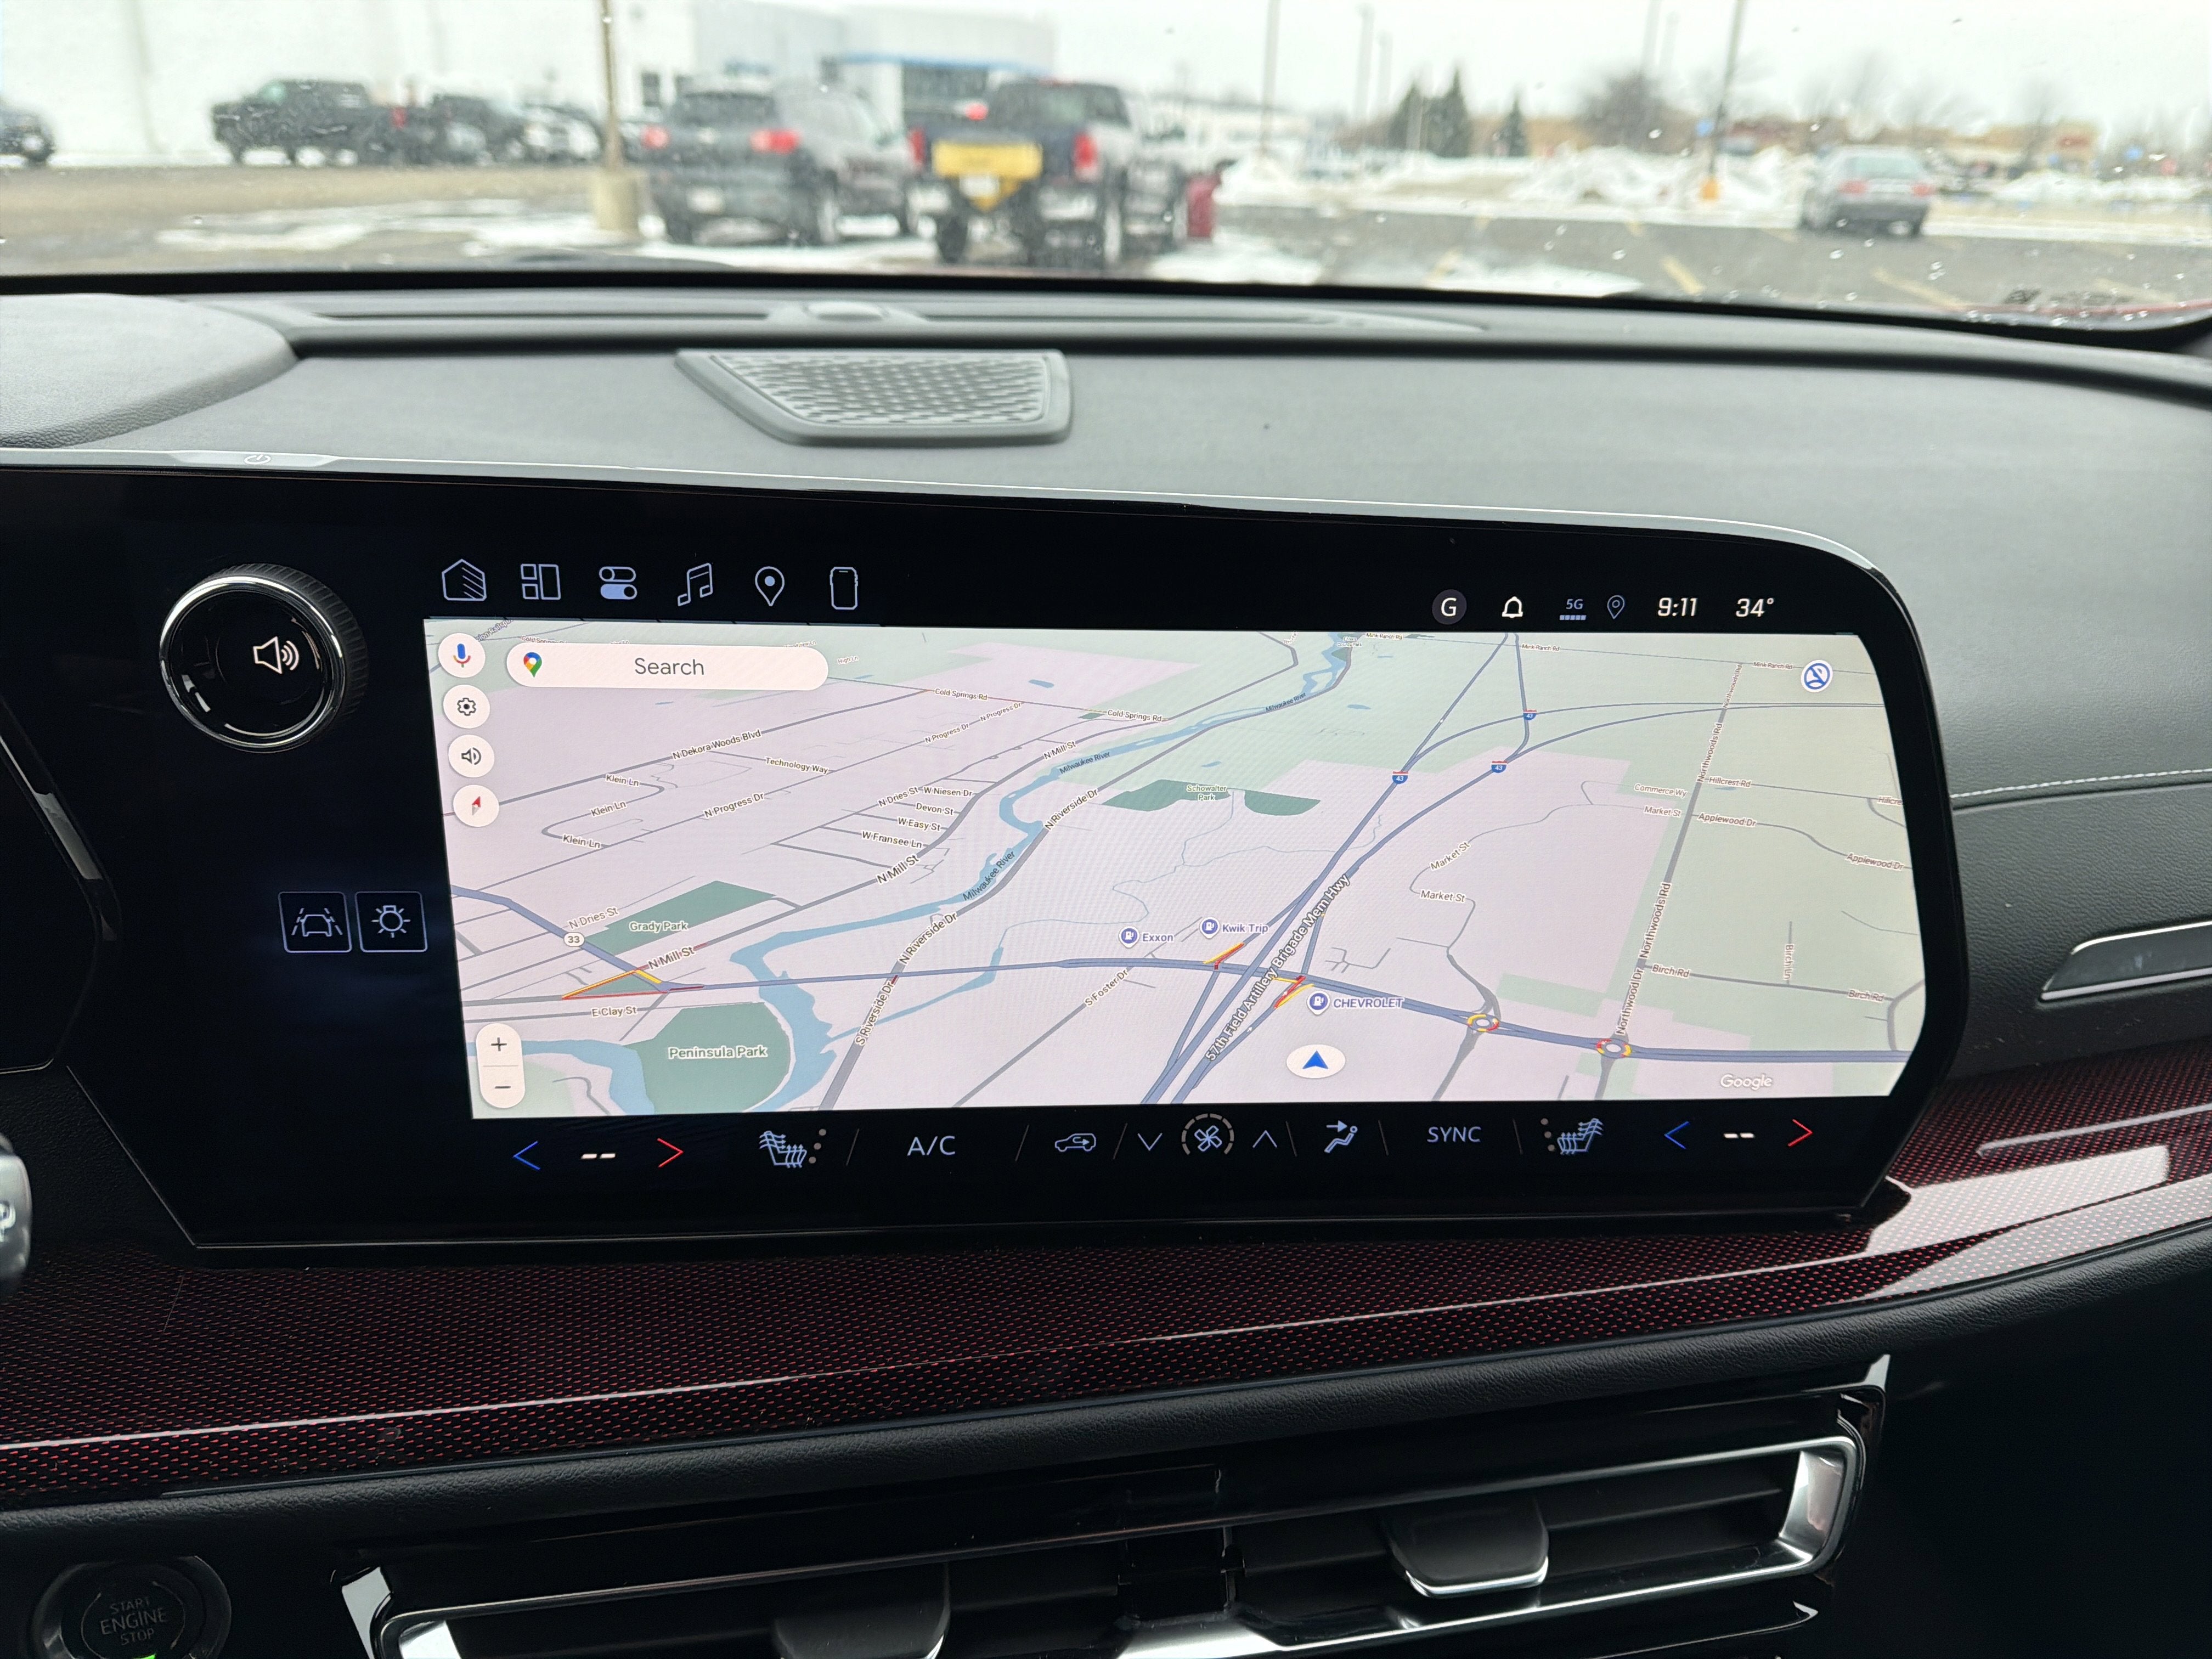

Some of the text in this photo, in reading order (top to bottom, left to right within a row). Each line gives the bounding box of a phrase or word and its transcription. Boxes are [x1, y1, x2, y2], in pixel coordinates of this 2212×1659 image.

[1441, 597, 1457, 616] G
[1566, 599, 1583, 610] 5G
[1658, 598, 1697, 617] 9:11
[1736, 598, 1774, 617] 34°
[635, 658, 704, 675] Search
[935, 689, 950, 697] Cold
[952, 690, 977, 700] Springs
[1723, 664, 1742, 708] Northwoods Rd
[1266, 692, 1306, 712] Milwaukee River
[987, 706, 1013, 720] Progress
[1125, 711, 1151, 720] Springs
[932, 726, 961, 742] Progress
[682, 743, 711, 757] Dekora
[712, 736, 741, 748] Woods
[742, 730, 761, 741] Blvd
[1051, 744, 1066, 758] Mill
[1067, 741, 1076, 749] St
[1697, 724, 1722, 782] Northwoods Rd
[766, 757, 828, 775] Technology Way
[1059, 752, 1110, 774] Milwaukee River
[606, 775, 639, 786] Klein Ln
[1709, 777, 1740, 786] Hillcrest
[888, 792, 908, 803] Dries
[1635, 784, 1686, 797] Commerce Wy
[591, 801, 626, 817] Klein Ln
[704, 793, 764, 817] N Progress Dr
[916, 803, 941, 813] Devon
[1045, 788, 1098, 830] N Riverside Dr
[1878, 797, 1903, 805] Hillcre
[1645, 806, 1671, 816] Market
[1699, 813, 1744, 826] Applewood
[909, 820, 929, 831] Easy
[563, 834, 601, 849] Klein Ln
[873, 833, 909, 845] Fransee
[911, 839, 922, 848] Ln
[1431, 842, 1470, 870] Market St
[1847, 853, 1892, 868] Applewood
[878, 855, 919, 884] N Mill St
[963, 851, 1015, 901] Milwaukee River
[1421, 890, 1465, 902] Market St
[569, 907, 618, 929] N Dries St
[1640, 883, 1671, 958] Northwoods Rd
[630, 922, 687, 932] Grady Park
[1249, 924, 1269, 934] Trip
[567, 935, 580, 944] 33
[899, 912, 957, 964] N Riverside Dr
[648, 946, 694, 969] N Mill St
[1784, 945, 1793, 979] Birch Ln
[1206, 874, 1351, 1060] 57th Field Artillery Brigade Mem Hwy
[1652, 964, 1690, 977] Birch Rd
[1085, 969, 1128, 1006] S Foster Dr
[1849, 990, 1884, 1002] Birch Rd
[1333, 998, 1403, 1008] CHEVROLET
[1616, 969, 1644, 1034] Northwood Dr
[601, 1007, 623, 1017] Clay
[856, 981, 894, 1046] S Riverside Dr
[669, 1046, 767, 1058] Peninsula Park
[1720, 1074, 1772, 1091] Google
[1427, 1126, 1481, 1142] SYNC
[907, 1136, 955, 1156] A/C
[110, 1596, 150, 1614] START
[100, 1608, 168, 1635] ENGINE
[121, 1628, 154, 1645] STOP
